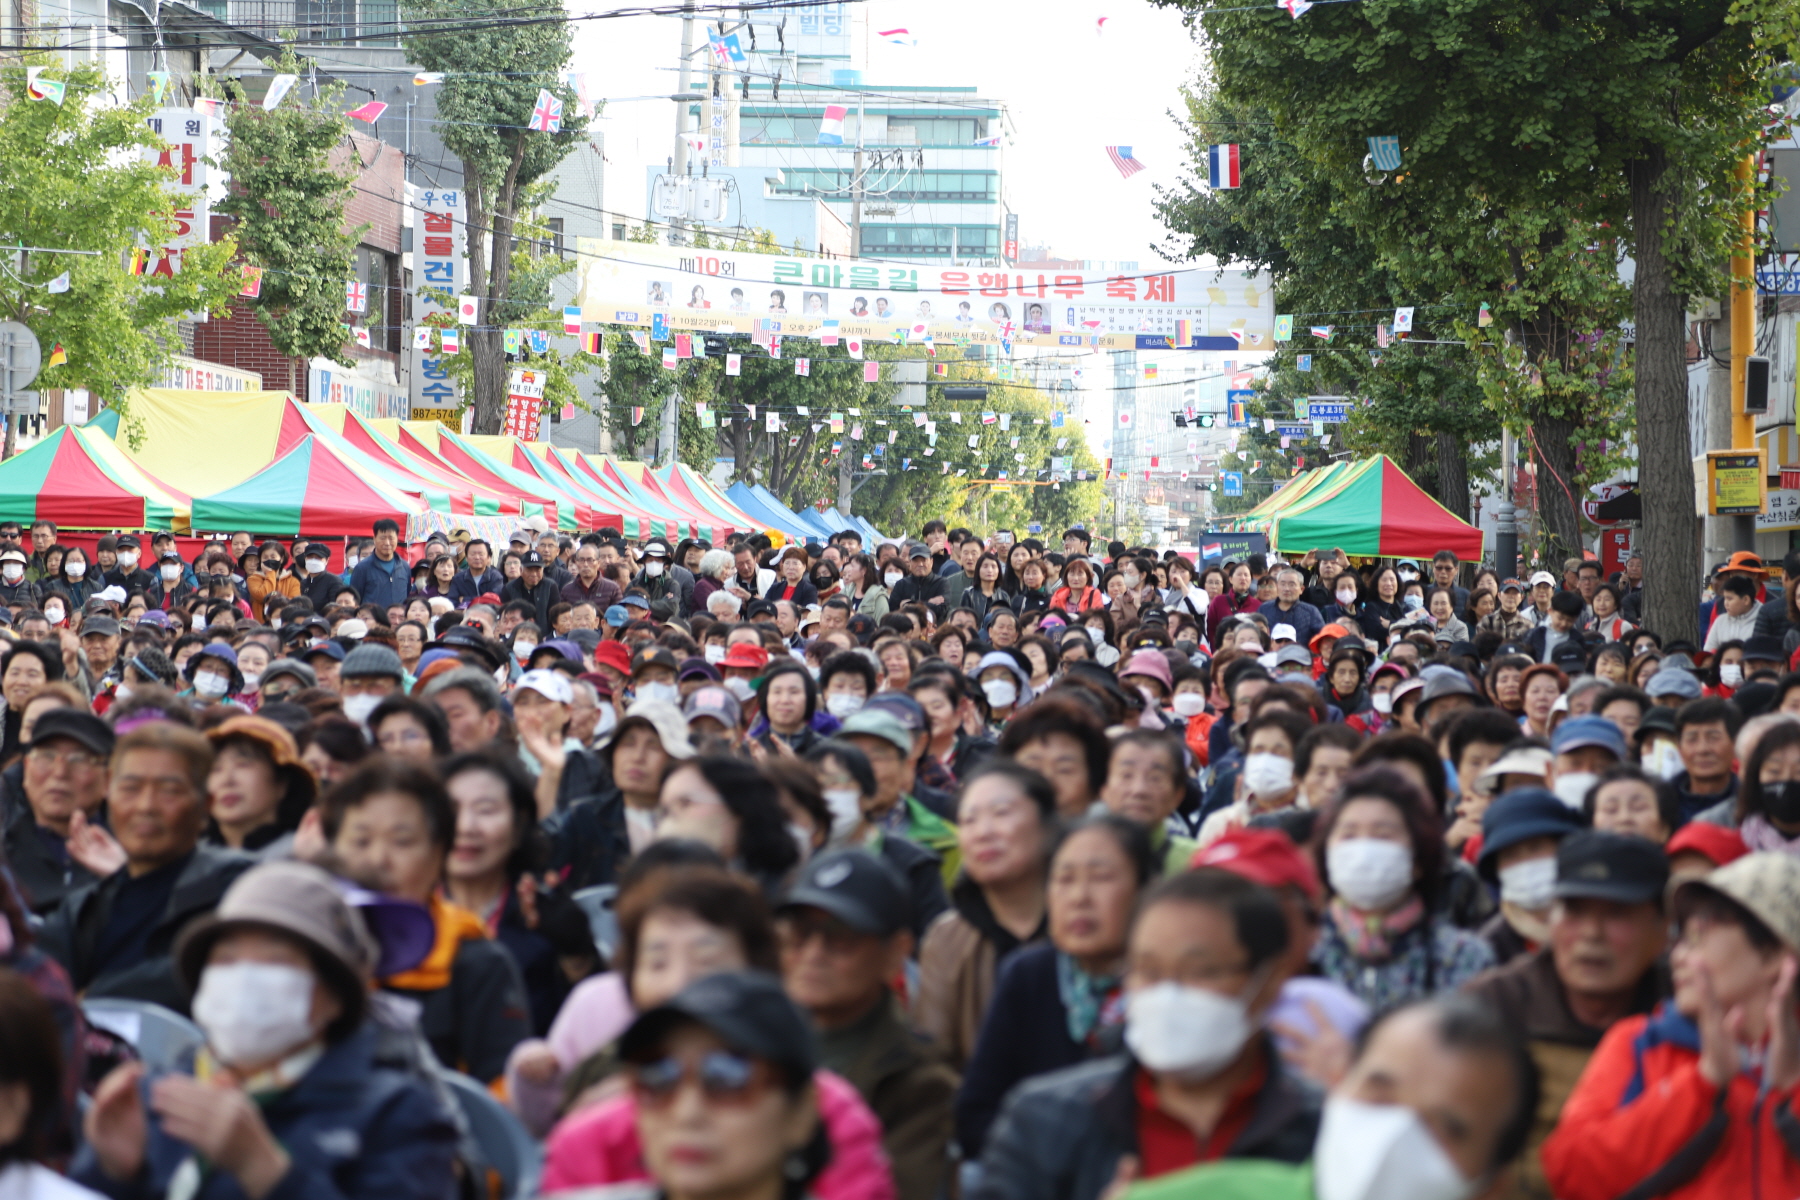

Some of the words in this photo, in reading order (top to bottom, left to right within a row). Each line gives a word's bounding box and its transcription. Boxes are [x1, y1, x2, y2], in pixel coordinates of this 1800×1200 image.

[800, 16, 842, 35] 빌딩
[420, 191, 458, 207] 우연
[679, 256, 736, 277] 제10회
[773, 260, 918, 292] 큰마을길
[940, 271, 1086, 300] 은행나무
[1106, 274, 1176, 303] 축제
